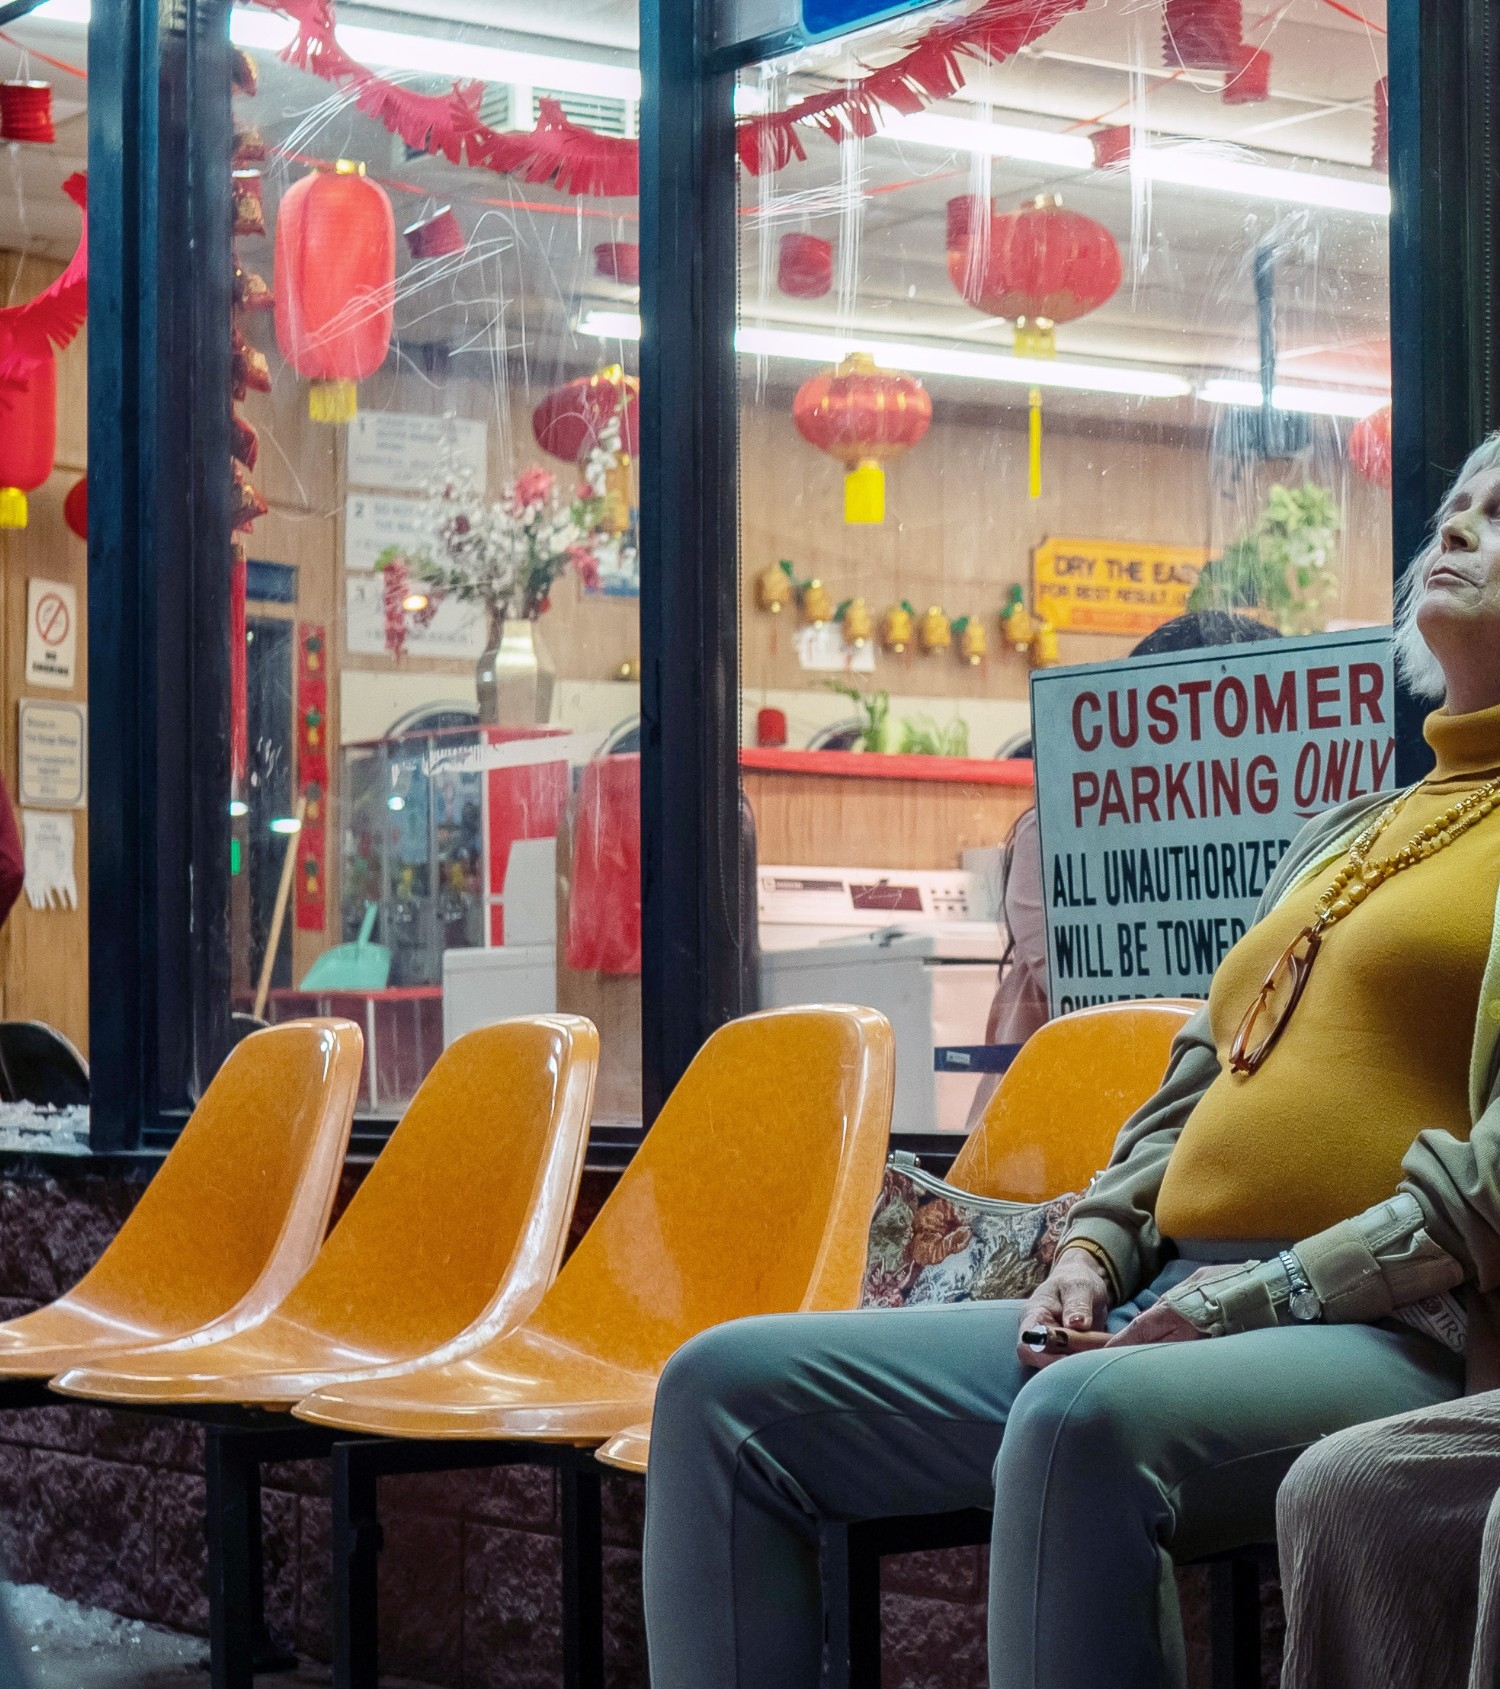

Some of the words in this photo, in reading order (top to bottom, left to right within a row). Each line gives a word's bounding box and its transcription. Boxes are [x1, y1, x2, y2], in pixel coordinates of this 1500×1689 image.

[1054, 554, 1097, 577] DRY
[1104, 558, 1144, 582] THE
[1072, 662, 1386, 752] CUSTOMER
[1072, 754, 1280, 828] PARKING
[1294, 736, 1396, 809] ONLY
[1053, 853, 1098, 908] ALL
[1054, 924, 1114, 979] WILL
[1117, 922, 1150, 978] BE
[1437, 1312, 1466, 1350] IRS
